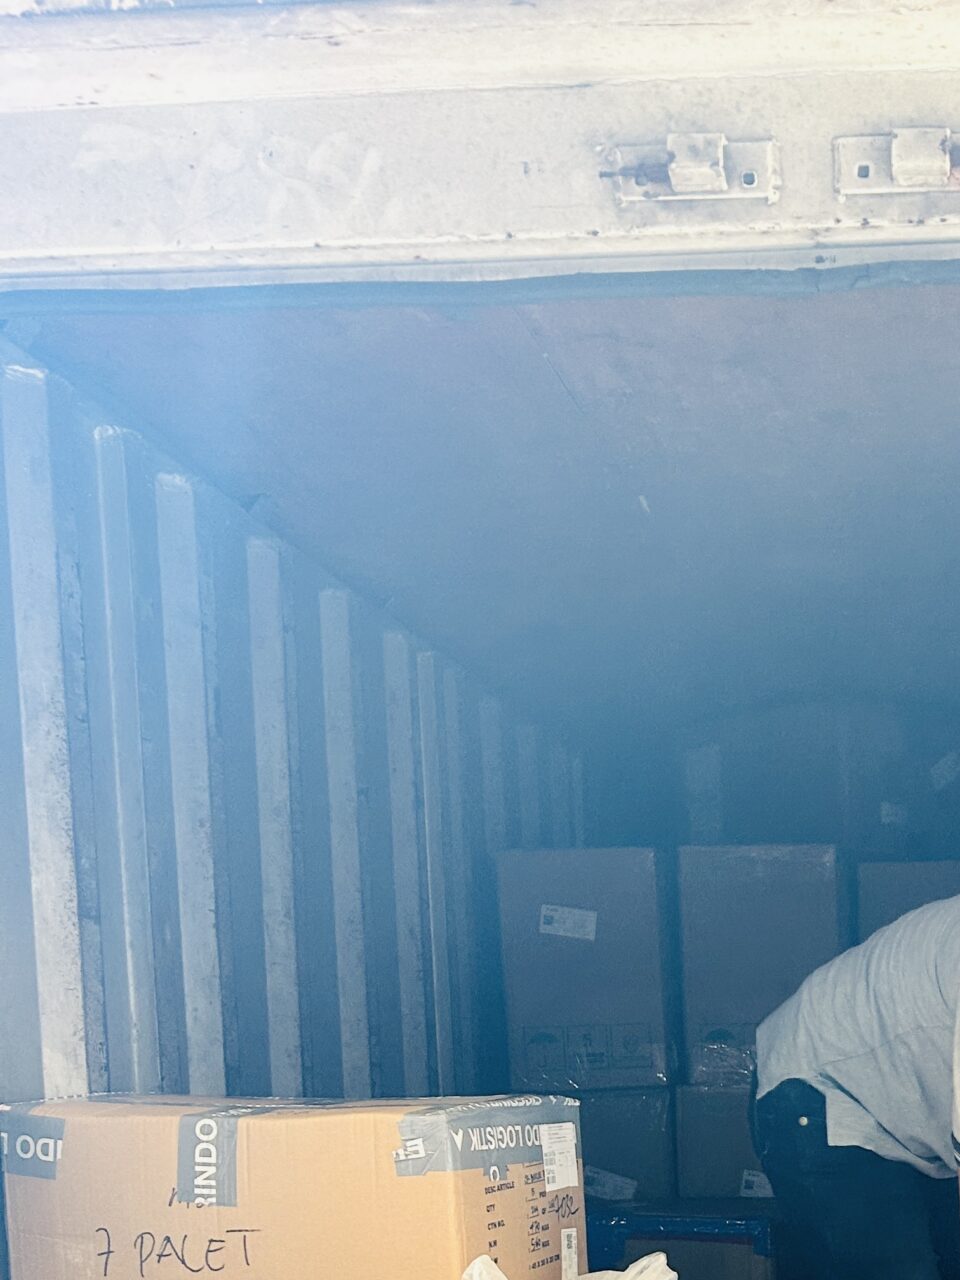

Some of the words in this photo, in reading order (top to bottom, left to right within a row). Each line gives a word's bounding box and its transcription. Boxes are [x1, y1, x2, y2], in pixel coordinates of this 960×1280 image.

[16, 1135, 62, 1162] DO
[468, 1124, 524, 1151] LOGISTIK
[96, 1227, 114, 1277] 7
[134, 1229, 262, 1278] PALET
